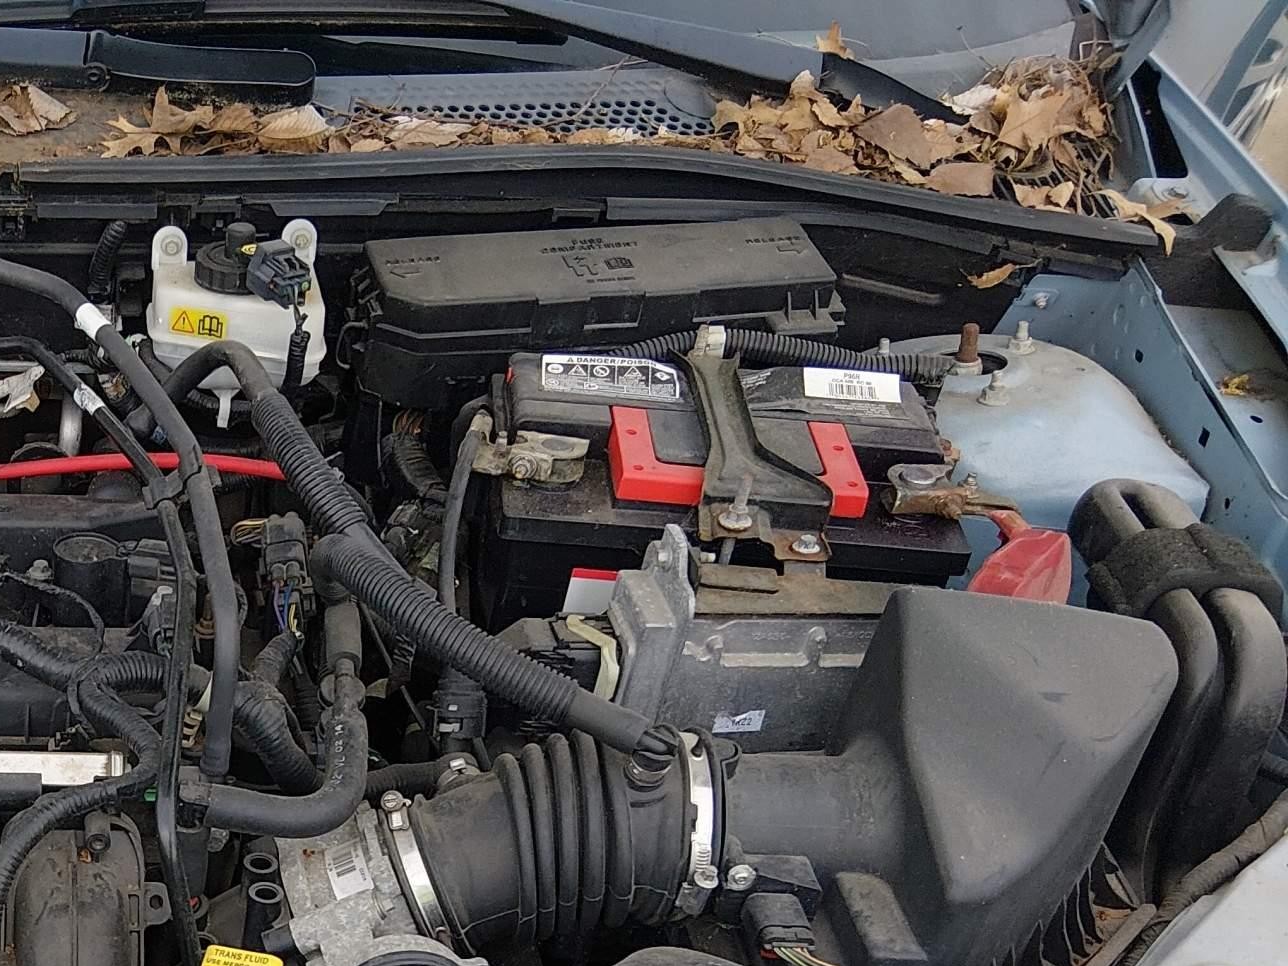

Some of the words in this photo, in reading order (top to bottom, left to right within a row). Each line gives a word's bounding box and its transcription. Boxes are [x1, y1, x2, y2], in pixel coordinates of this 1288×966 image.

[576, 357, 657, 368] DANGER/POISON
[214, 948, 243, 960] TRANS
[243, 953, 270, 965] FLUID
